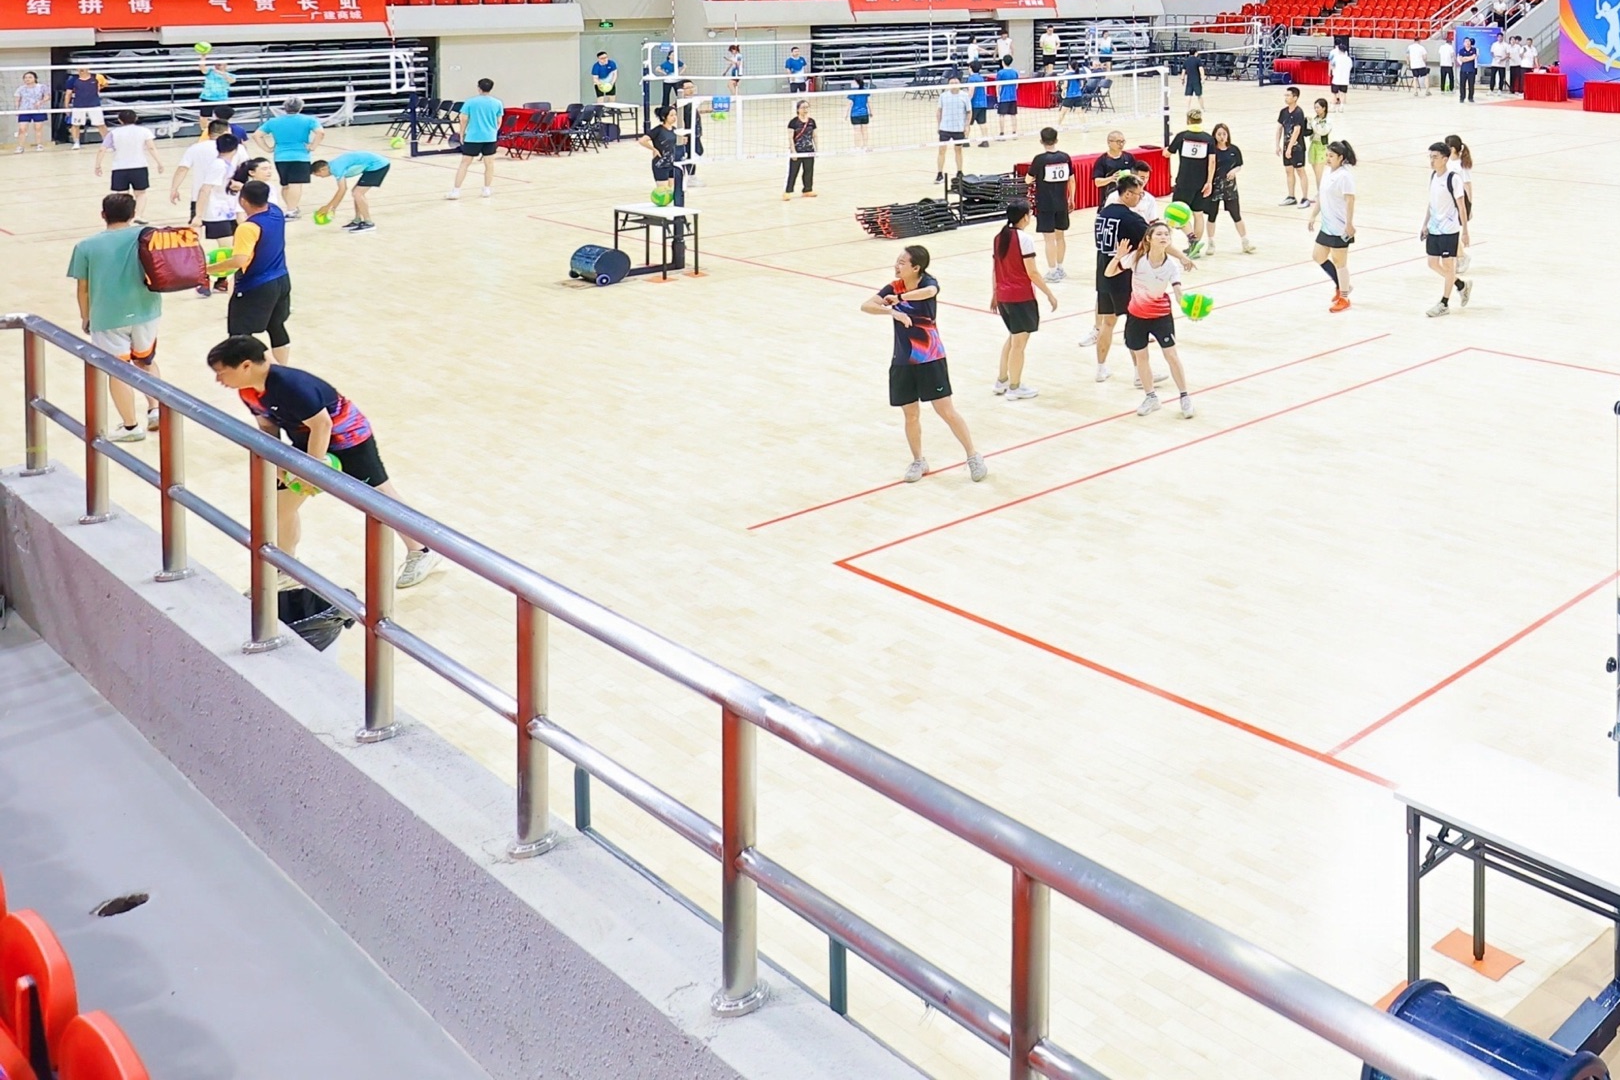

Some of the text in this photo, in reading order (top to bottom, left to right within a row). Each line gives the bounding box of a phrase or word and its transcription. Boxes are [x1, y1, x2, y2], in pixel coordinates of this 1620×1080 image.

[1191, 147, 1198, 156] 9
[1052, 170, 1065, 180] 10
[148, 230, 200, 252] NIKE
